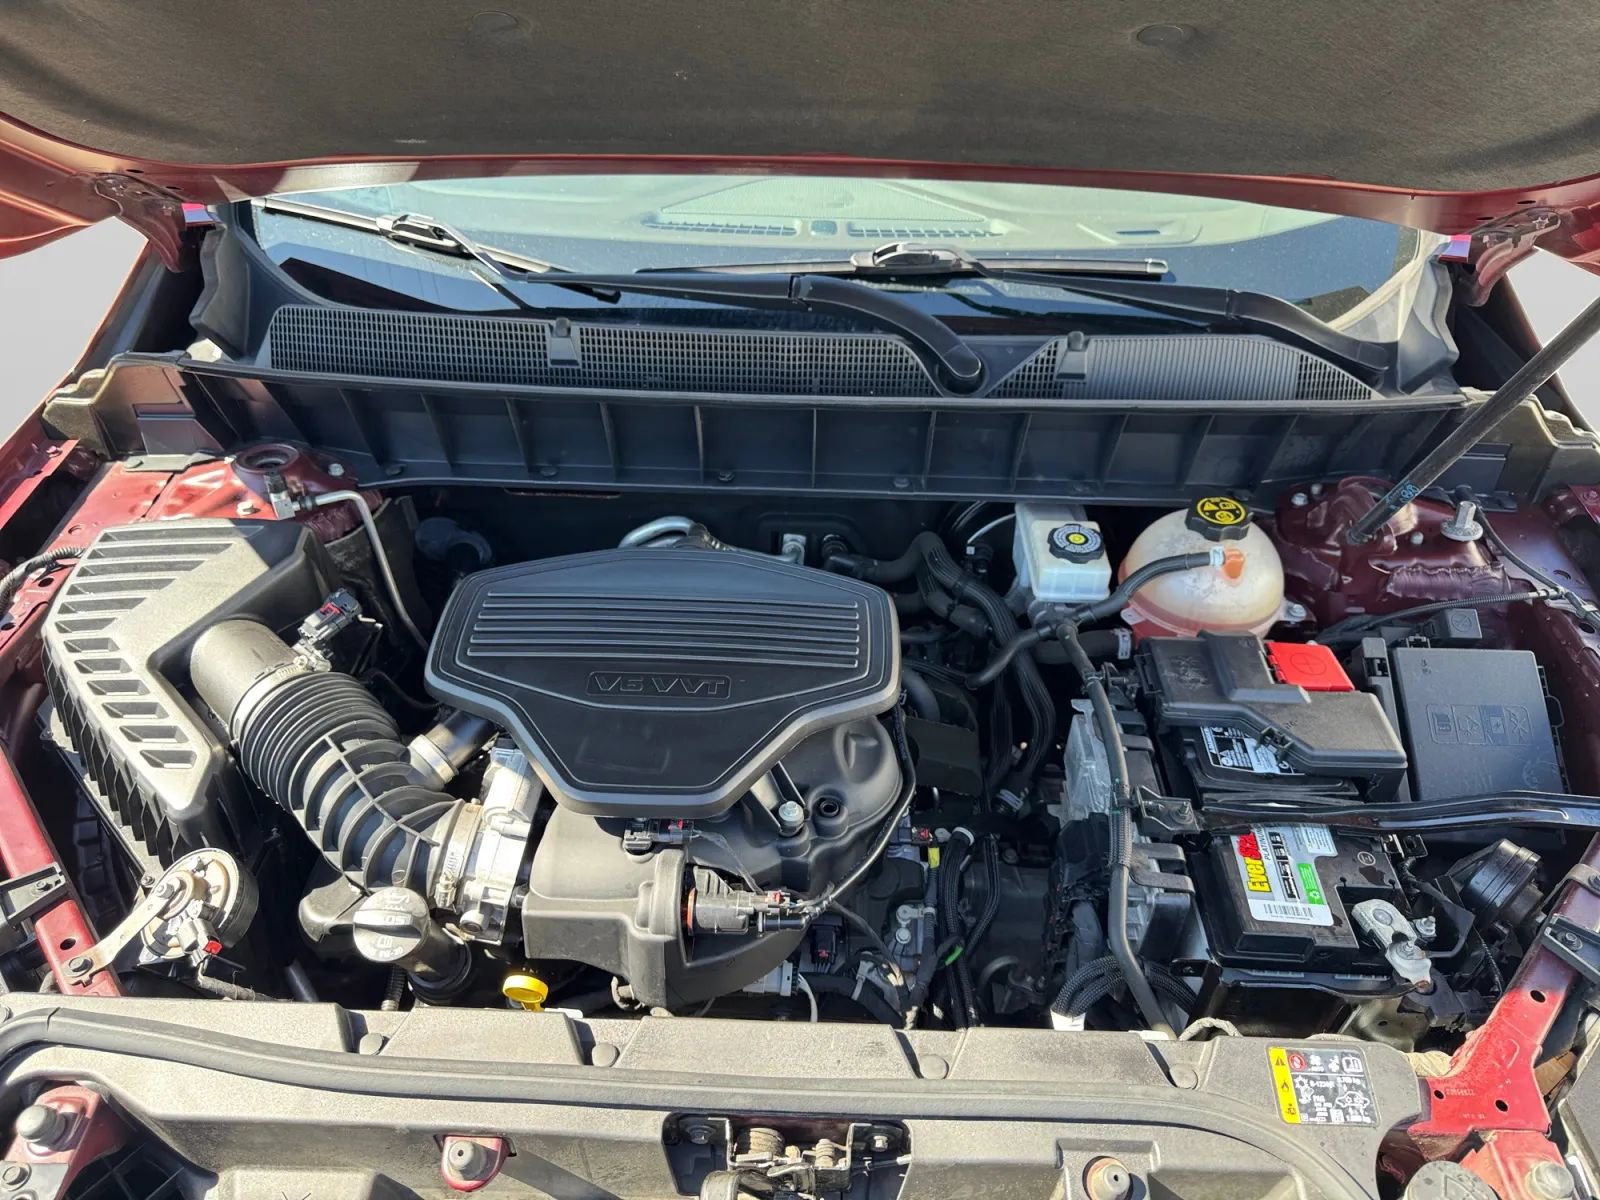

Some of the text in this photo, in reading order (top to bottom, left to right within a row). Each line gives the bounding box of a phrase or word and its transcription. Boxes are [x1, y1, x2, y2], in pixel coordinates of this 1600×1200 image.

[594, 676, 726, 695] V6 VVT
[1238, 832, 1271, 892] EverSta
